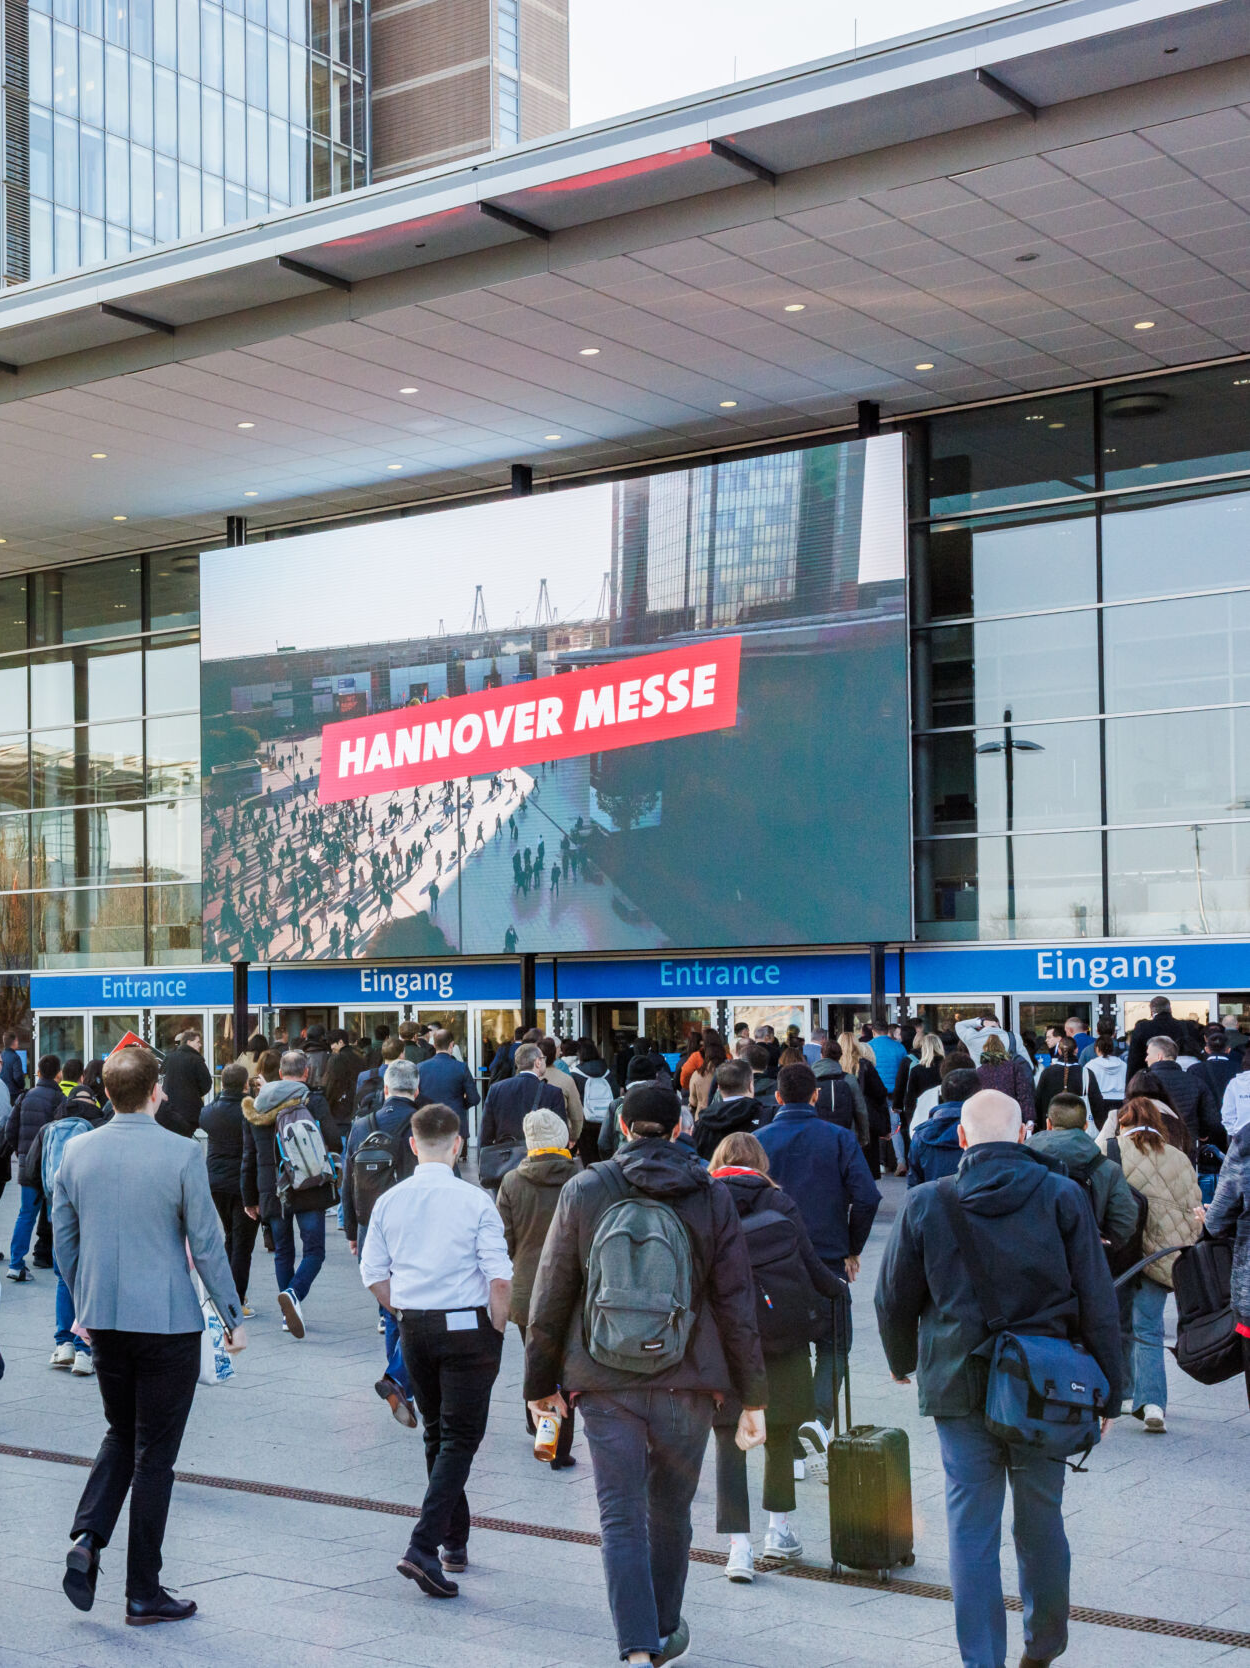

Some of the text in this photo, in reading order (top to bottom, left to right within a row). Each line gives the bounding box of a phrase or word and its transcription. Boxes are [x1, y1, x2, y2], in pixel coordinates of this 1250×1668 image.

[338, 663, 718, 778] HANNOVER MESSE
[360, 968, 454, 999] Eingang
[660, 962, 781, 987] Entrance
[1036, 950, 1177, 987] Eingang
[102, 977, 187, 999] Entrance
